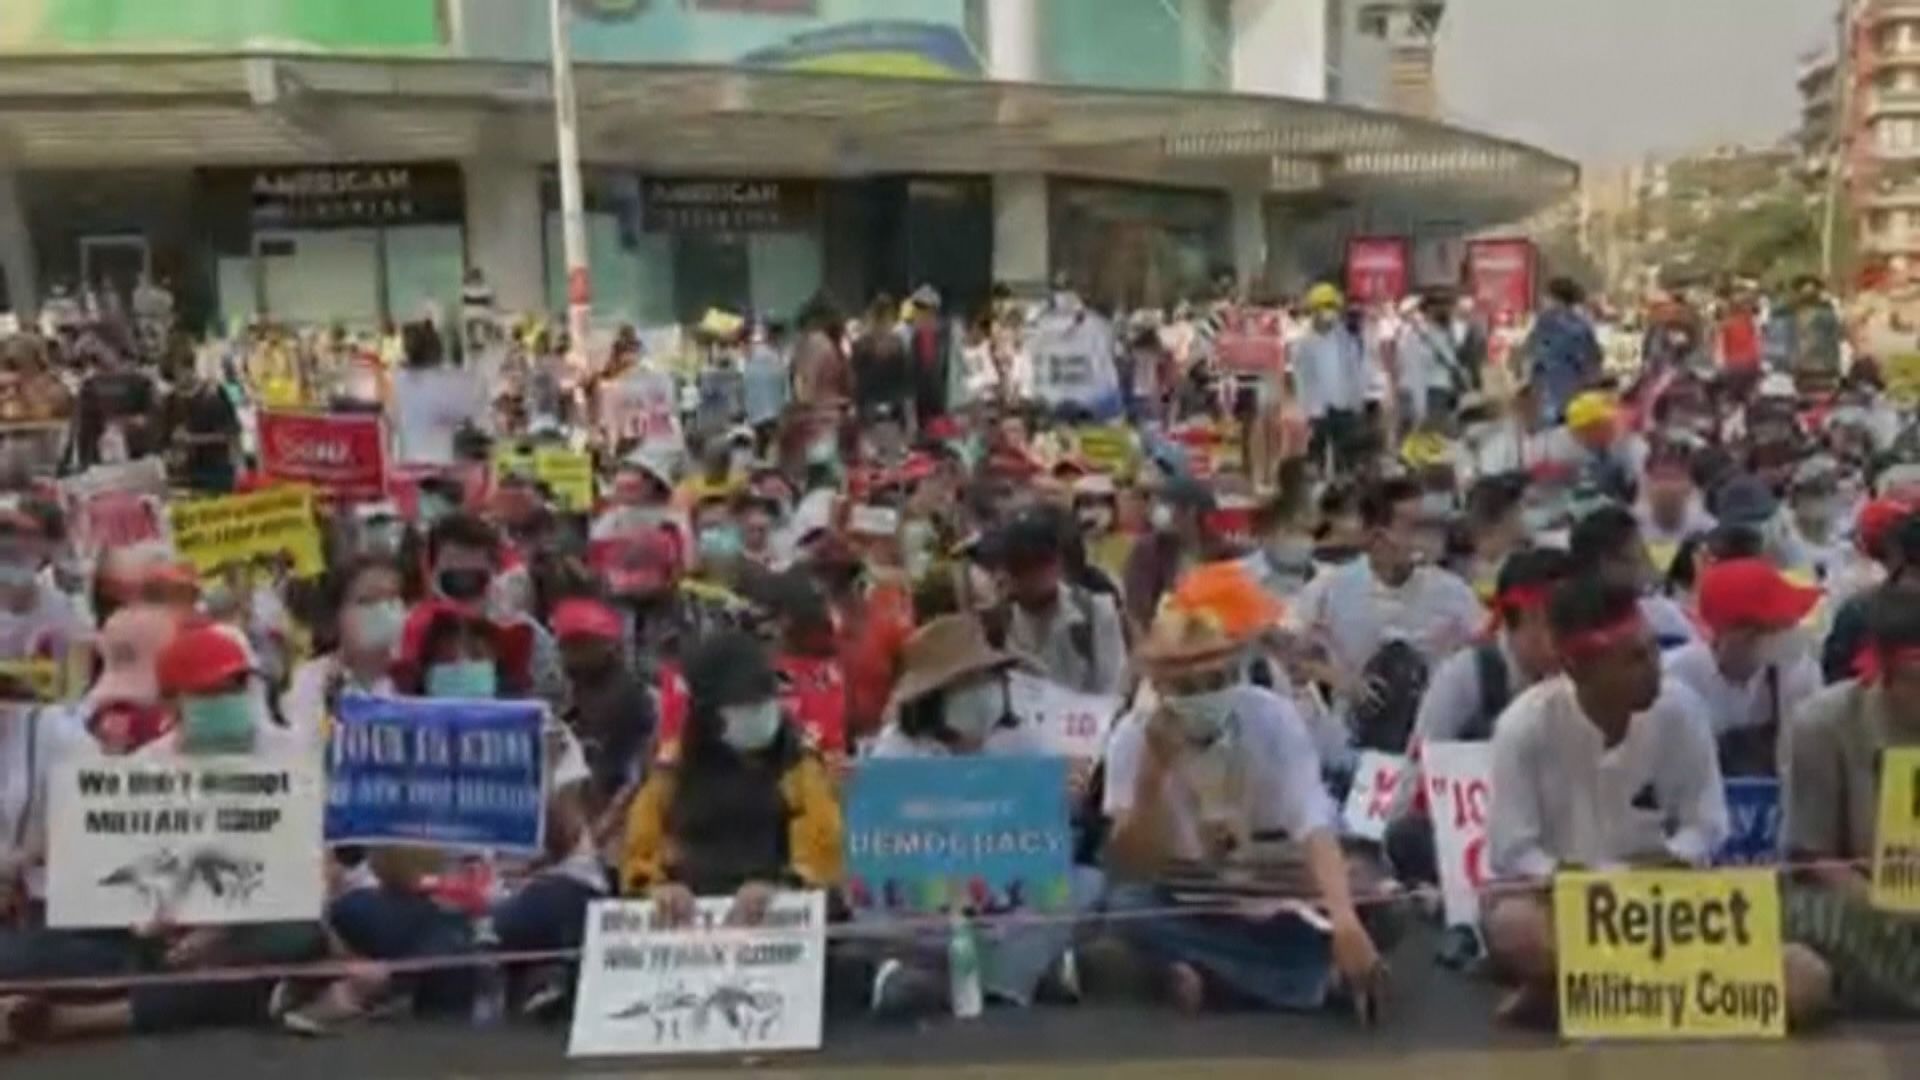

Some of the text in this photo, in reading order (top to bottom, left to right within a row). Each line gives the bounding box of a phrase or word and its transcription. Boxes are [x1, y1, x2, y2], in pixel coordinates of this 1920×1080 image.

[1586, 880, 1750, 962] Reject
[1566, 971, 1779, 1026] Military Coup
